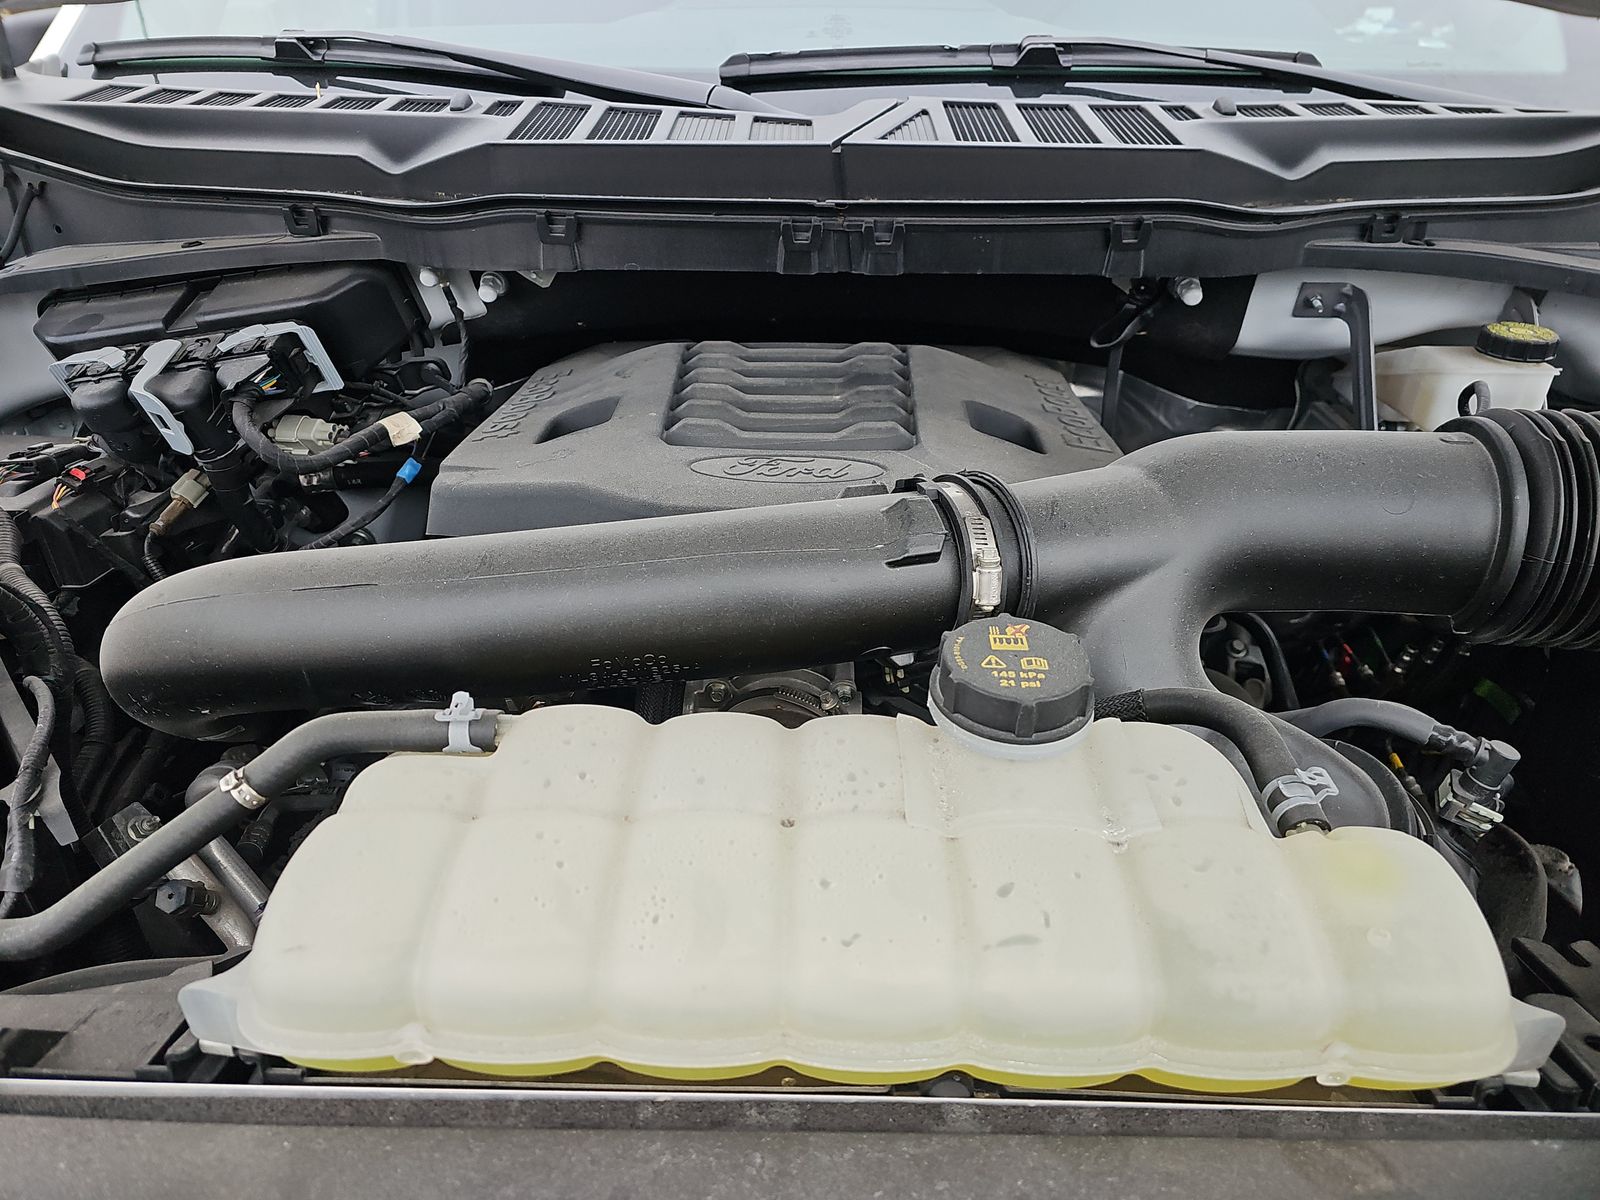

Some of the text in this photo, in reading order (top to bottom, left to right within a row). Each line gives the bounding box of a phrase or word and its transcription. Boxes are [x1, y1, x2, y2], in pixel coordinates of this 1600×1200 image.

[723, 457, 852, 479] Ford
[991, 670, 1046, 679] 145 kPa
[999, 679, 1041, 689] 21 psi
